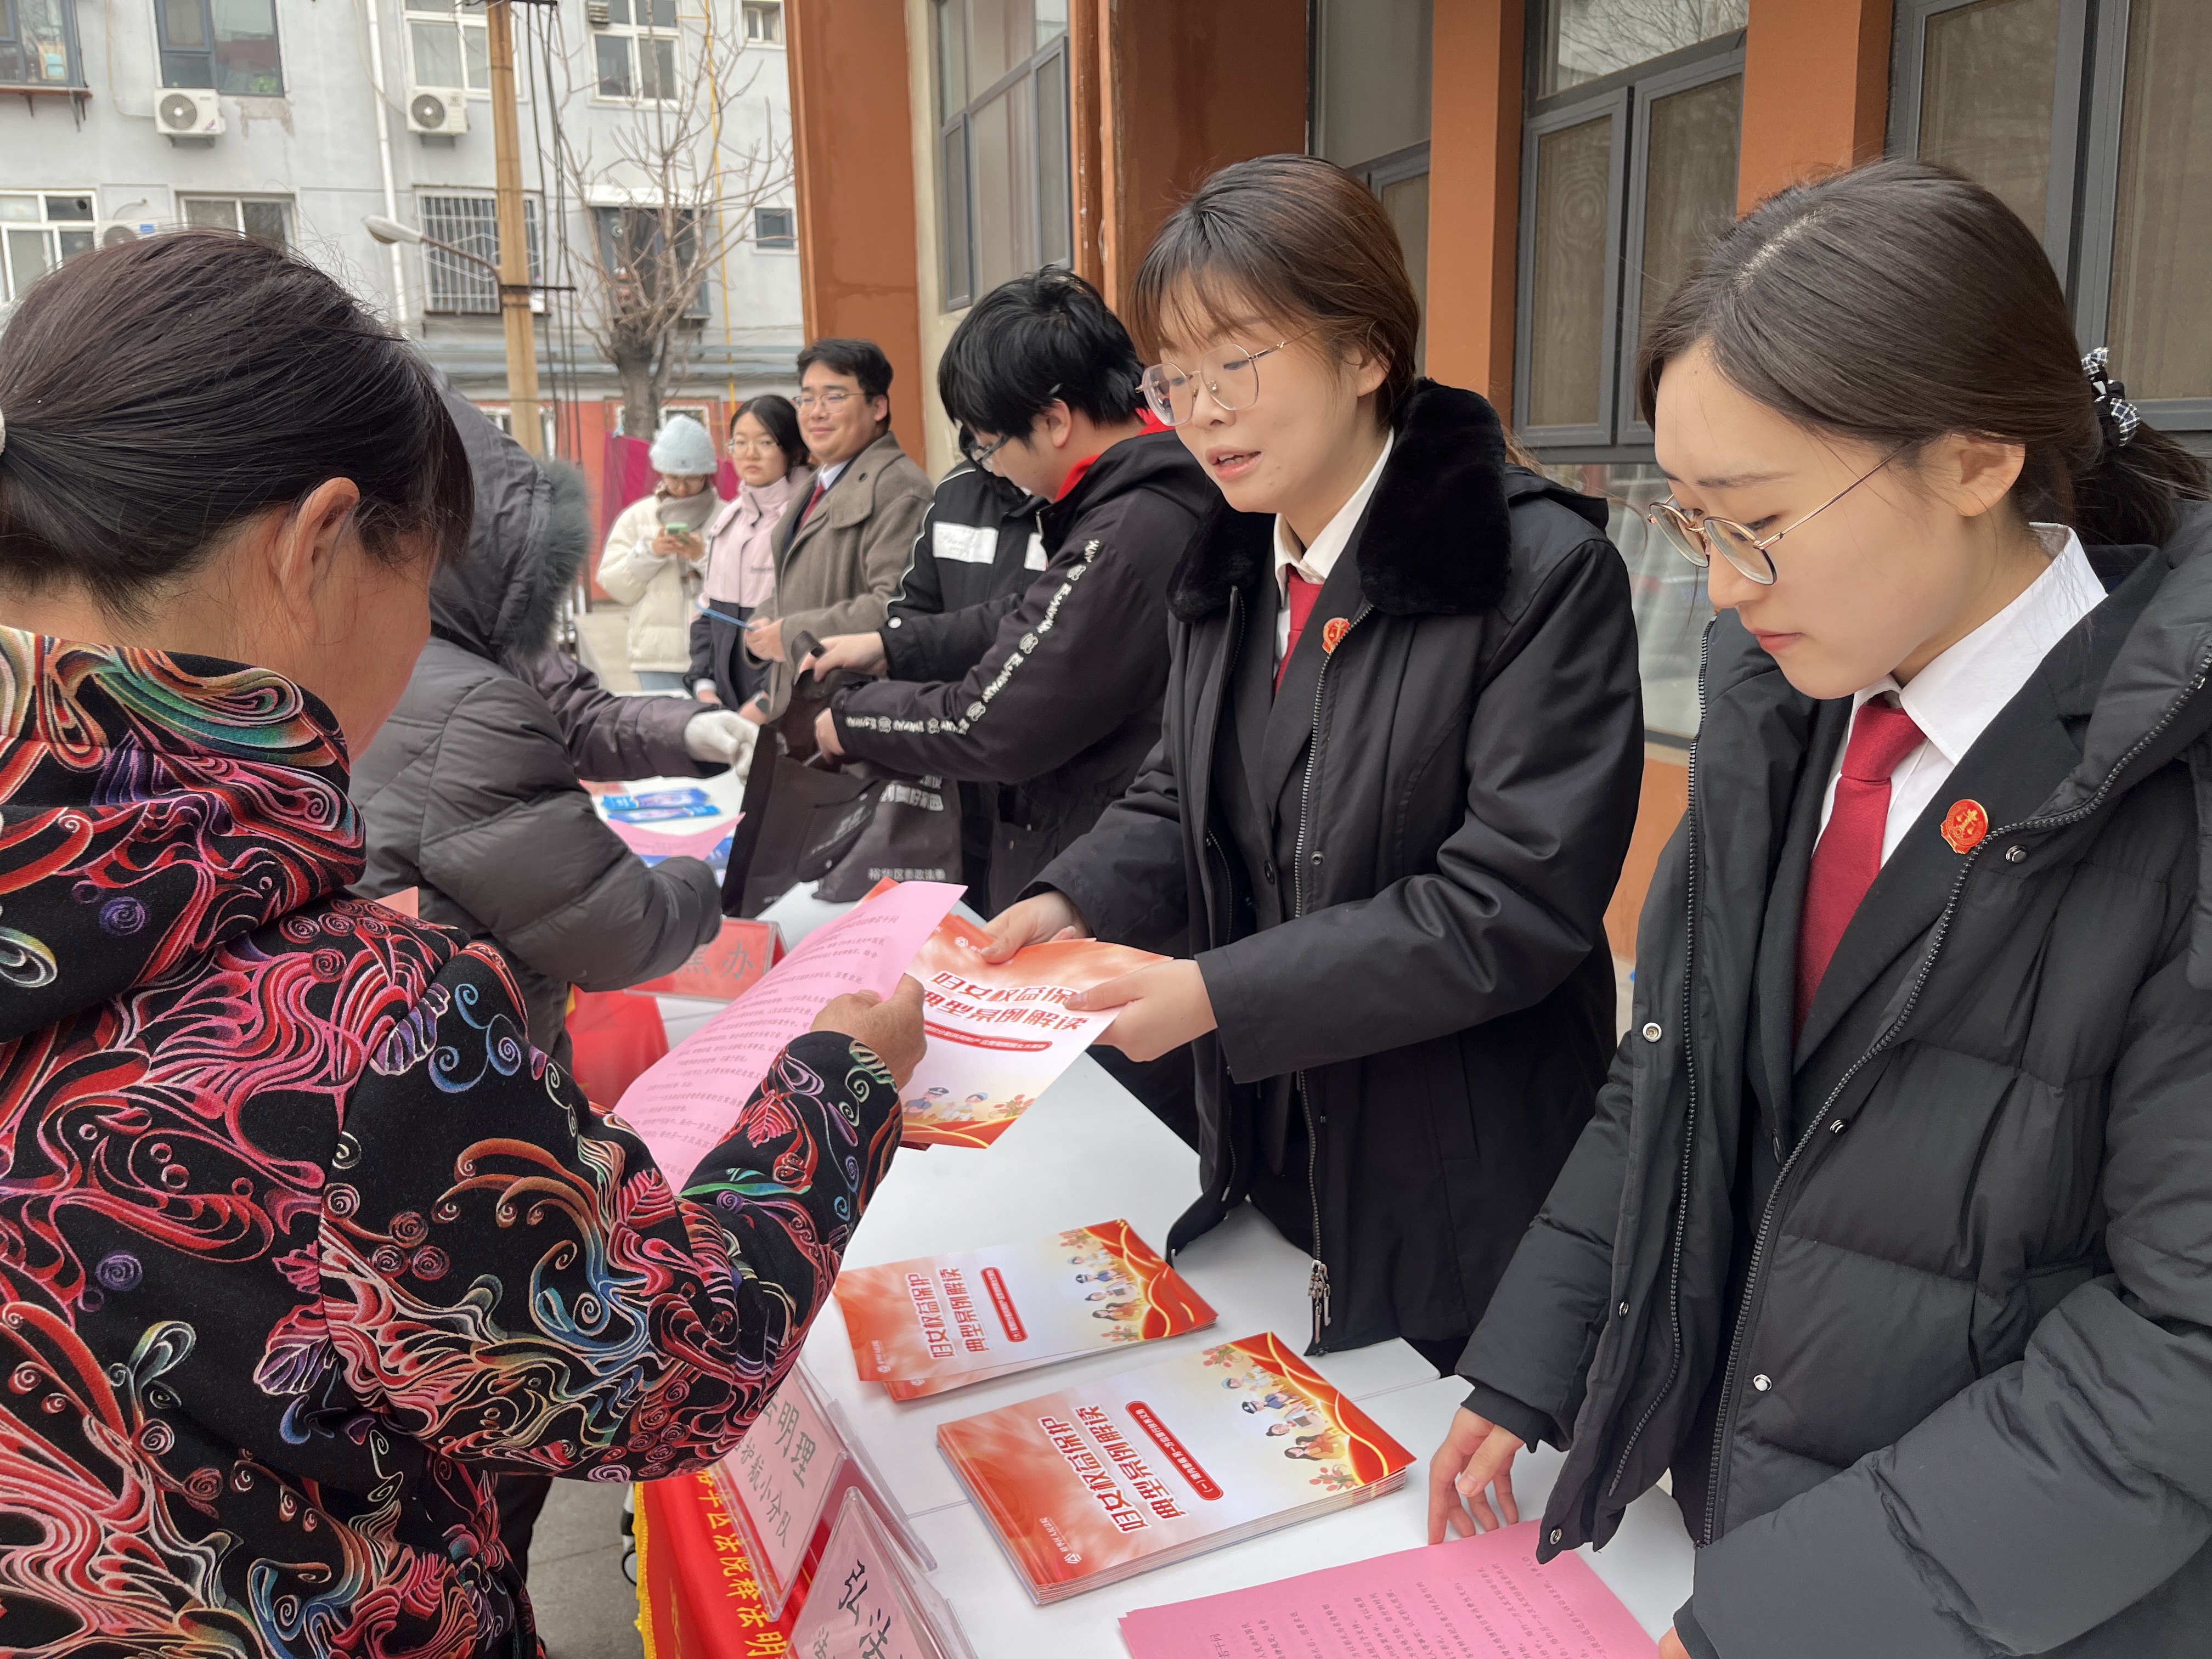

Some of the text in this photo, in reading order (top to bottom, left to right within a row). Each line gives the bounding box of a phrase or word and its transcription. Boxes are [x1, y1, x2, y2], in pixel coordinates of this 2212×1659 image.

[923, 989, 1091, 1031] 典型案例解读
[929, 971, 1080, 1006] 妇女权益保
[907, 1272, 957, 1359] 妇女权益保护
[939, 1267, 991, 1353] 典型案例解读
[1040, 1417, 1150, 1532] 妇女权益保护
[1074, 1404, 1188, 1520] 典型案例解读
[1353, 1596, 1402, 1659] 纠纷案件中，可以根据
[1369, 1593, 1422, 1659] 方当地习俗、给付的时间
[1454, 1582, 1519, 1659] 增进感情的日常消费性支出；
